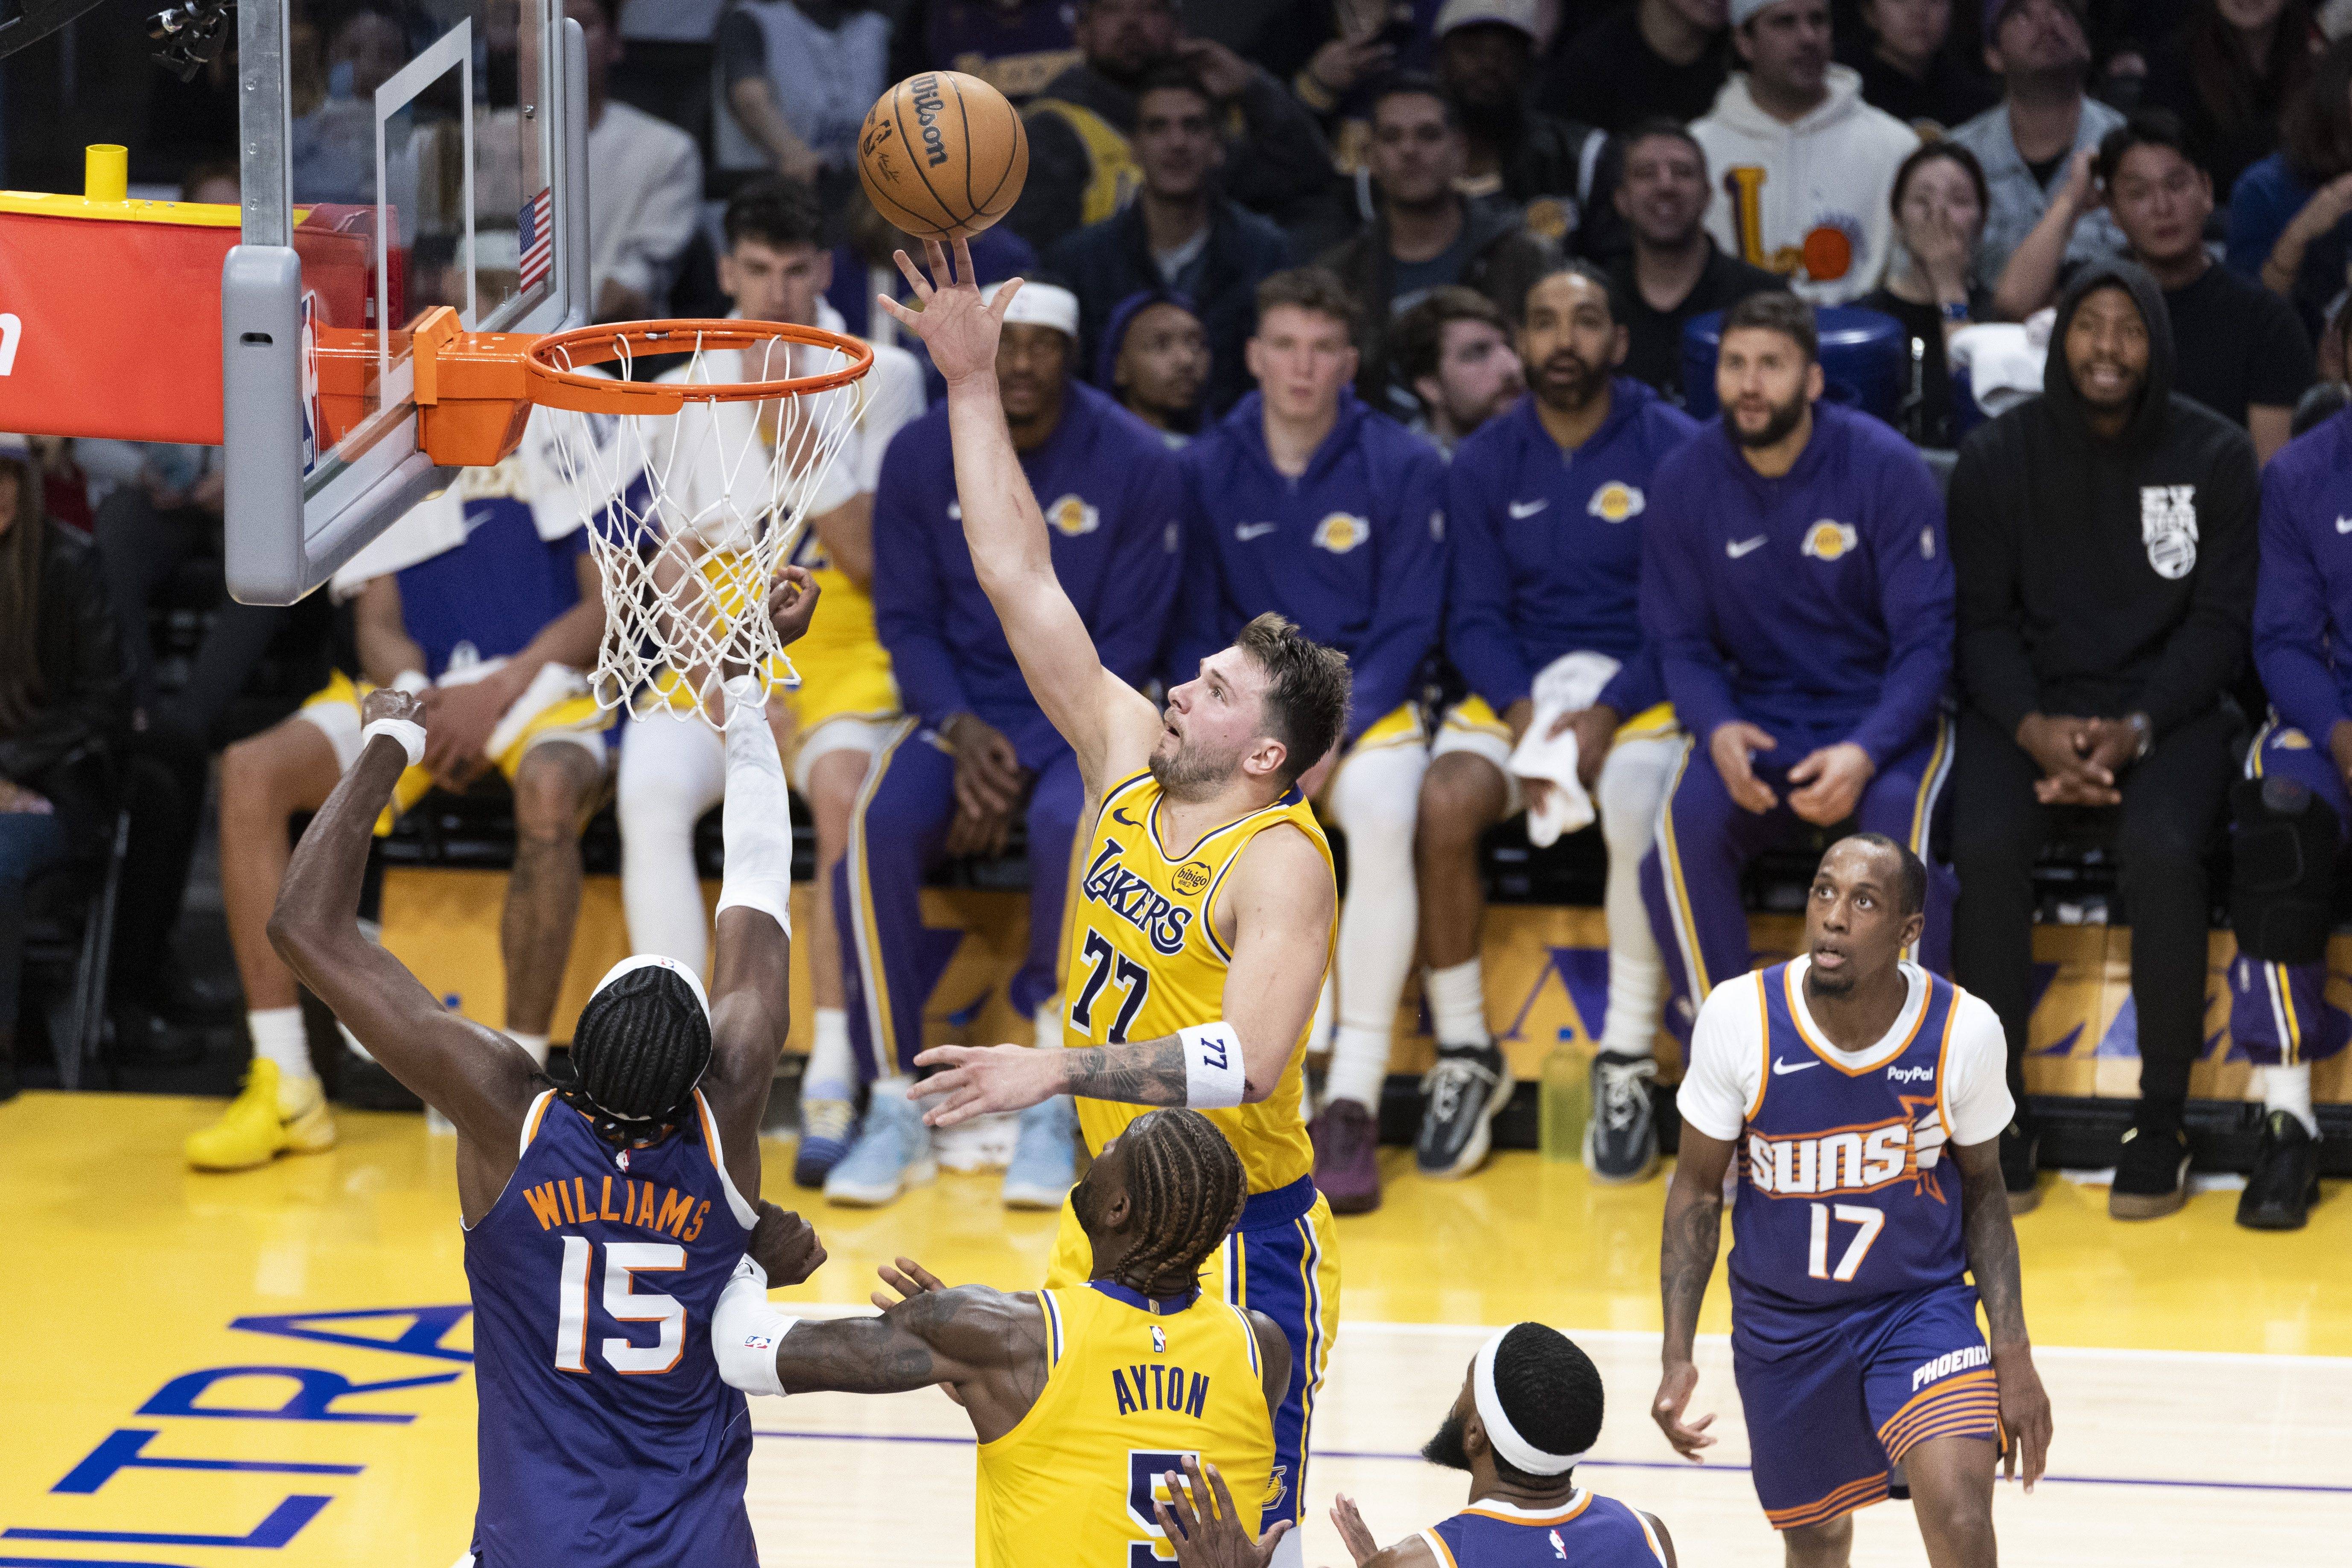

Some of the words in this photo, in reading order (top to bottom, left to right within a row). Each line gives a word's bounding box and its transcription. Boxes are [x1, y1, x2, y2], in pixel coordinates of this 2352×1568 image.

[909, 73, 948, 169] Wilson
[1083, 837, 1194, 957] LAKERS
[1177, 868, 1207, 887] bibigo
[1069, 925, 1149, 1044] 77
[1200, 1037, 1228, 1070] 77
[1887, 1066, 1933, 1084] PayPal
[523, 1175, 712, 1242] WILLIAMS
[1809, 1203, 1885, 1282] 17
[554, 1235, 688, 1375] 15
[1112, 1364, 1210, 1419] AYTON
[1912, 1346, 1991, 1392] PHOENIX
[0, 1304, 475, 1568] LTRA
[1126, 1449, 1201, 1568] 5
